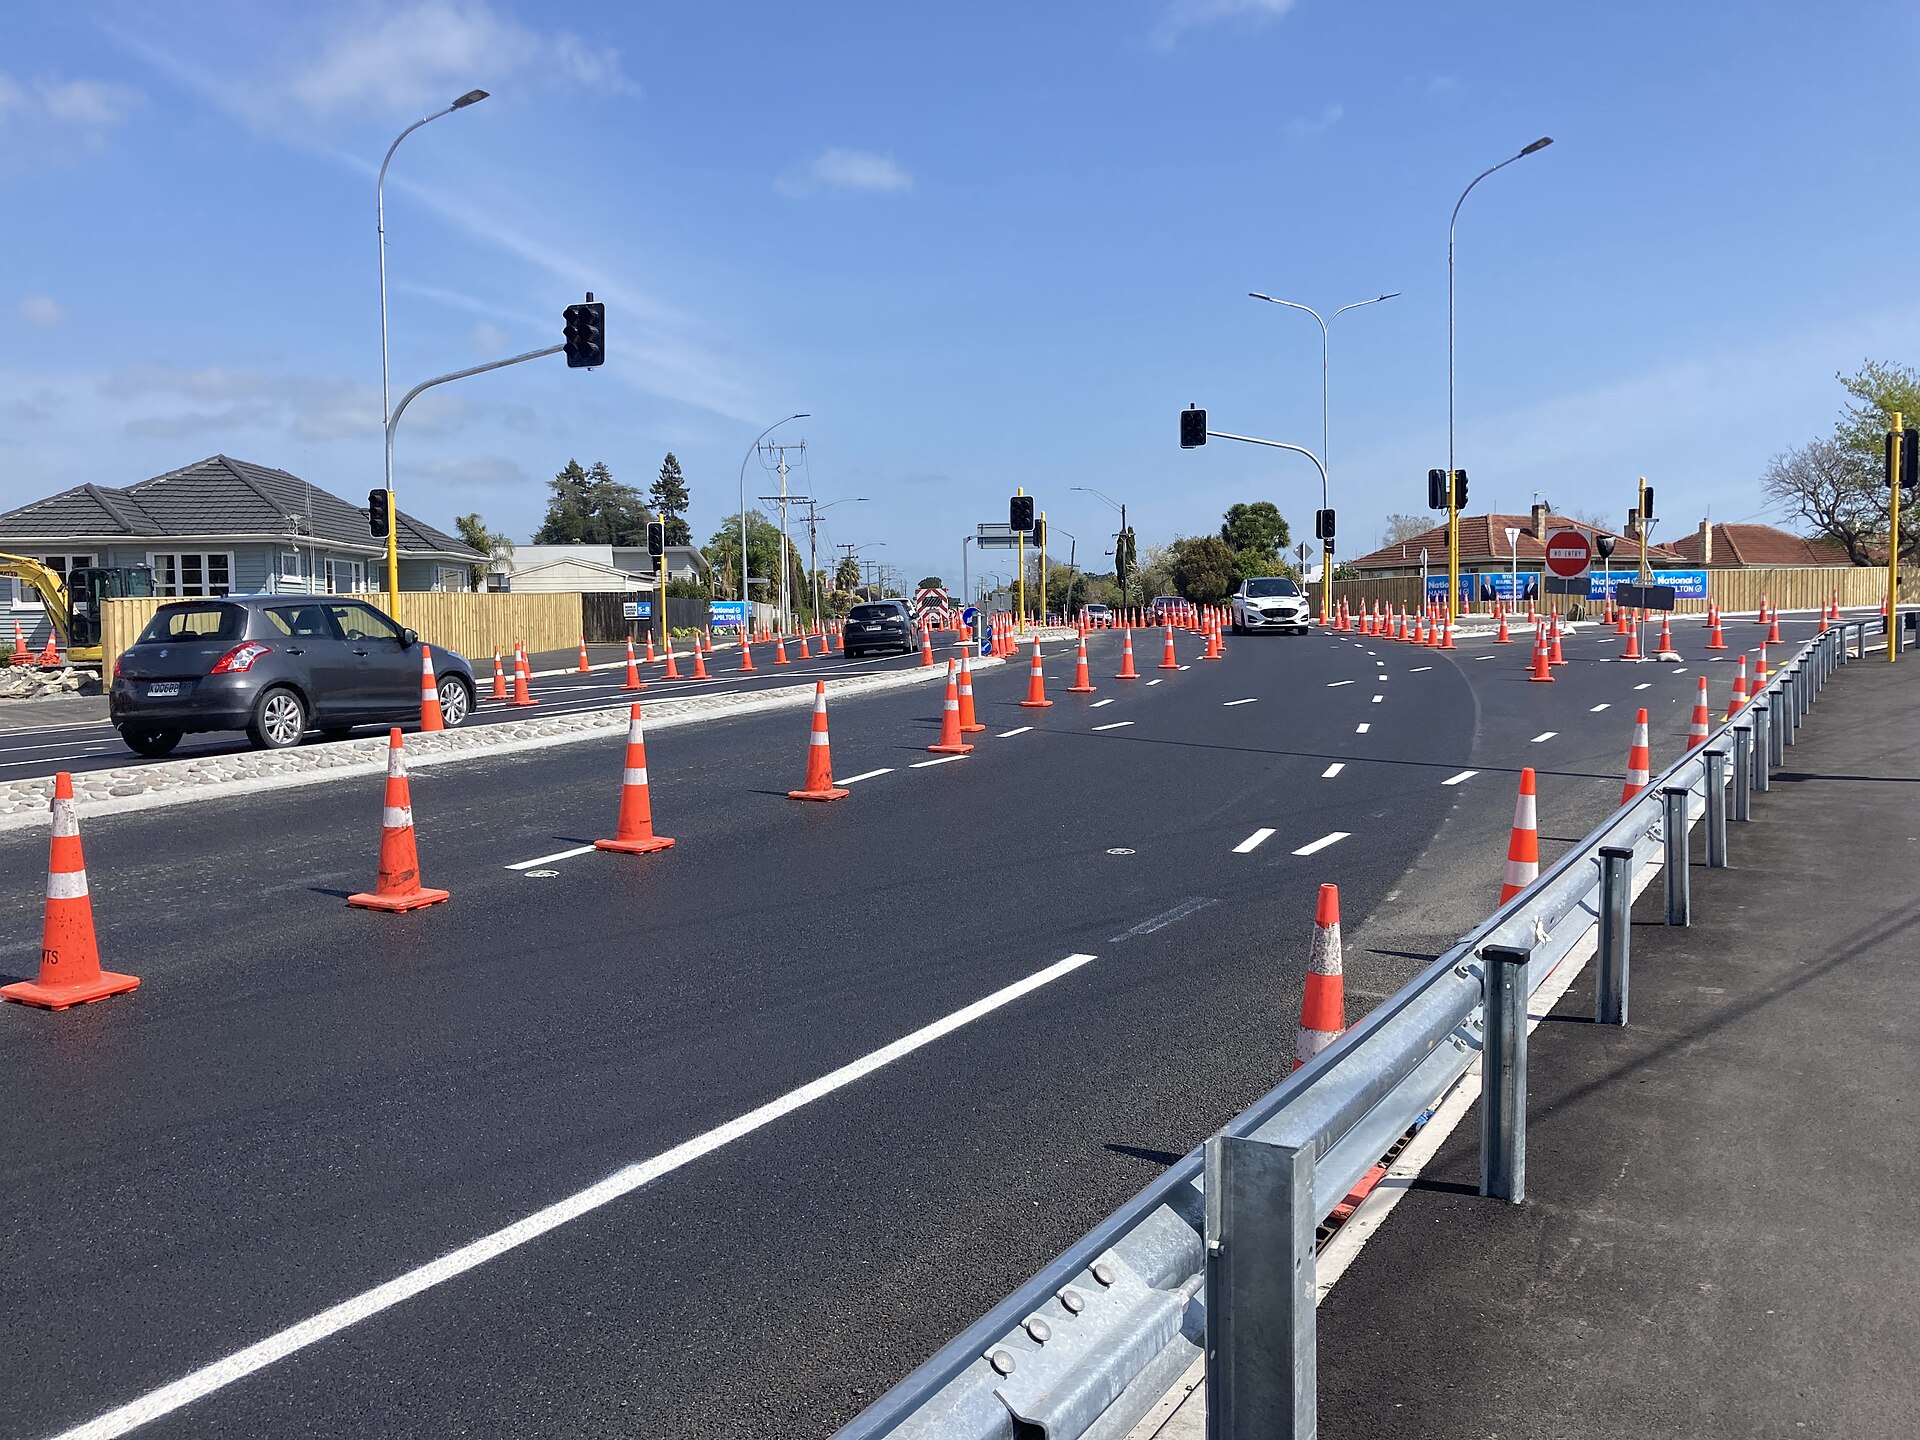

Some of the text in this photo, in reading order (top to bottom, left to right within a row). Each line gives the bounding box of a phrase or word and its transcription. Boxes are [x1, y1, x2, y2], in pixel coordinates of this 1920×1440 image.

[1564, 550, 1582, 558] ENTRY
[1657, 576, 1693, 585] National
[1428, 581, 1461, 589] Natiol
